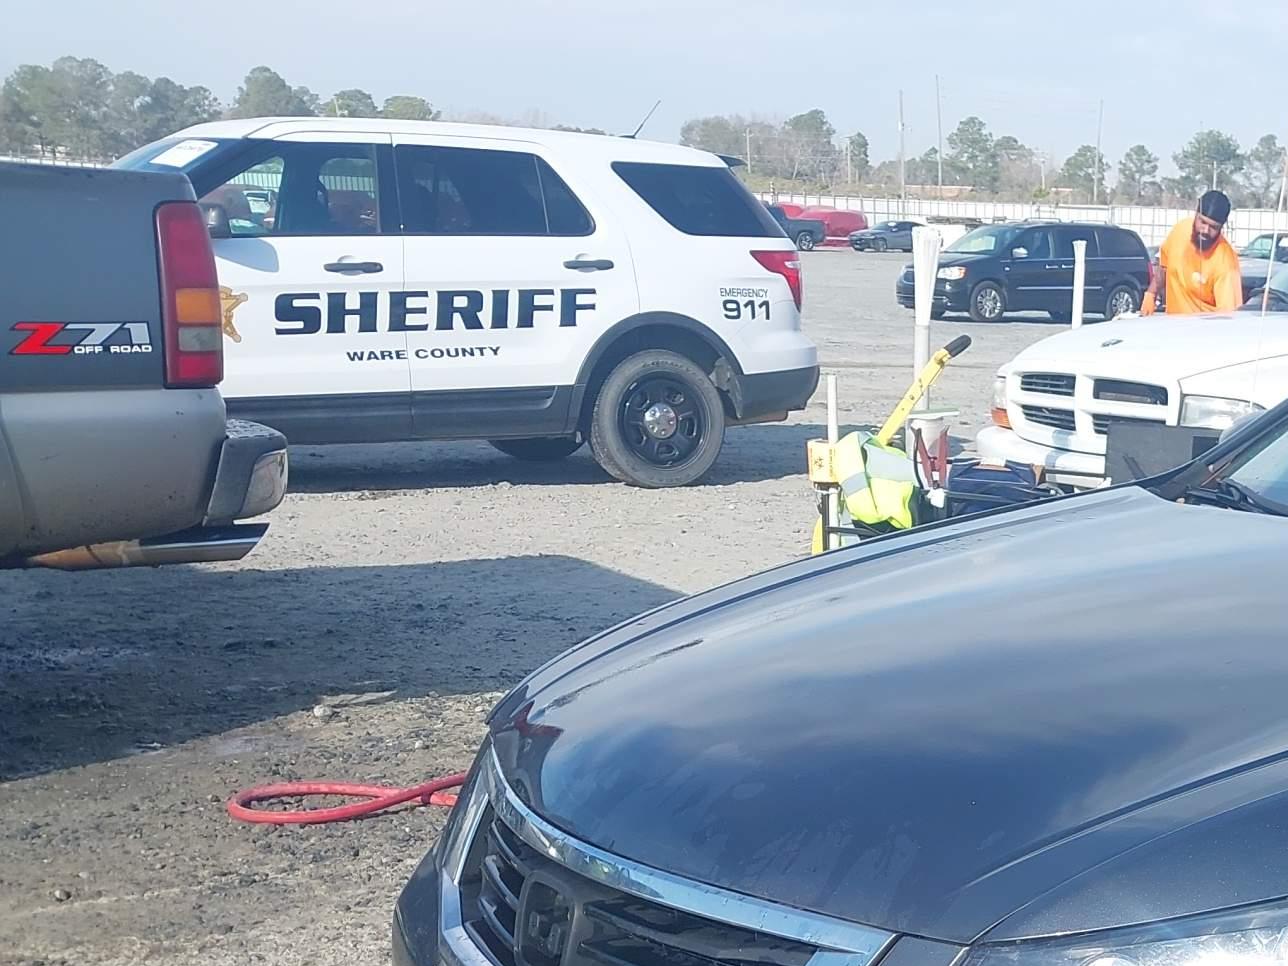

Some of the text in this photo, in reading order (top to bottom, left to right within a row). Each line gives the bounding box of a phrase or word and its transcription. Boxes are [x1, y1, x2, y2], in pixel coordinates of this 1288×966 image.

[719, 287, 768, 298] EMERGENCY
[274, 288, 597, 335] SHERIFF
[722, 299, 770, 321] 911
[9, 321, 152, 355] Z71
[73, 344, 153, 354] OFF ROAD
[346, 346, 501, 362] WARE COUNTY
